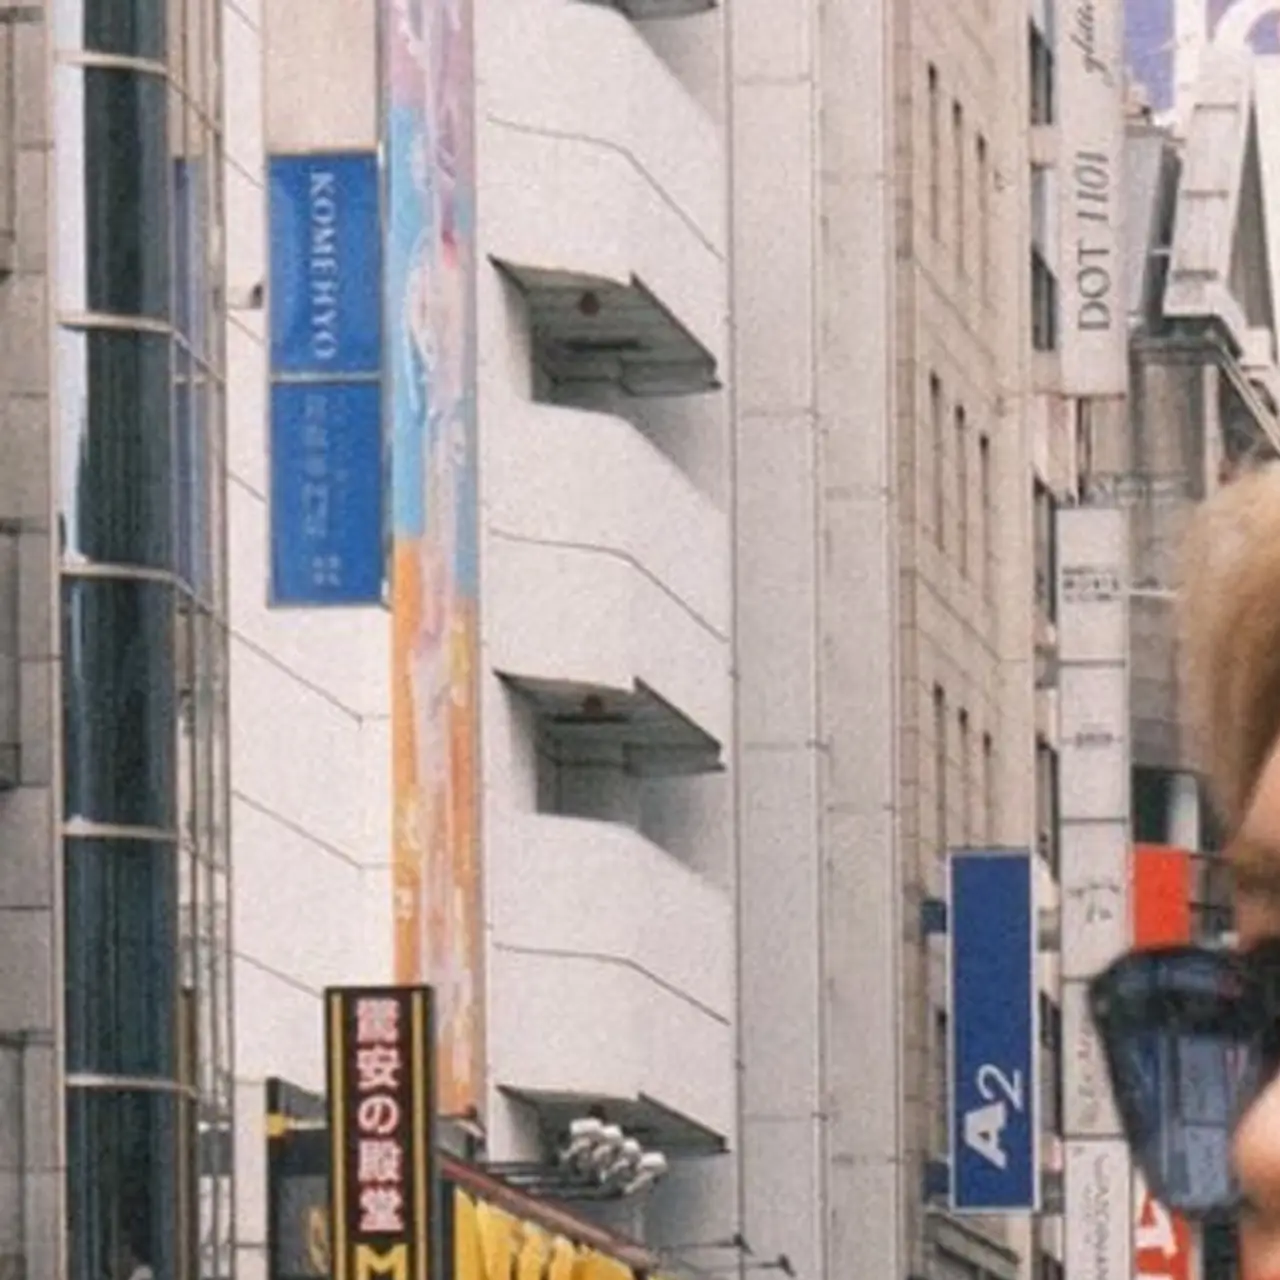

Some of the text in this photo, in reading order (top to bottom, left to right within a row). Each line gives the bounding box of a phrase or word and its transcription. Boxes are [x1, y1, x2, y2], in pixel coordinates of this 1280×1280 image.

[309, 170, 340, 361] KOMEHYO
[1077, 247, 1112, 331] DOT
[355, 998, 405, 1233] 驚安の殿堂
[963, 1063, 1024, 1170] A2
